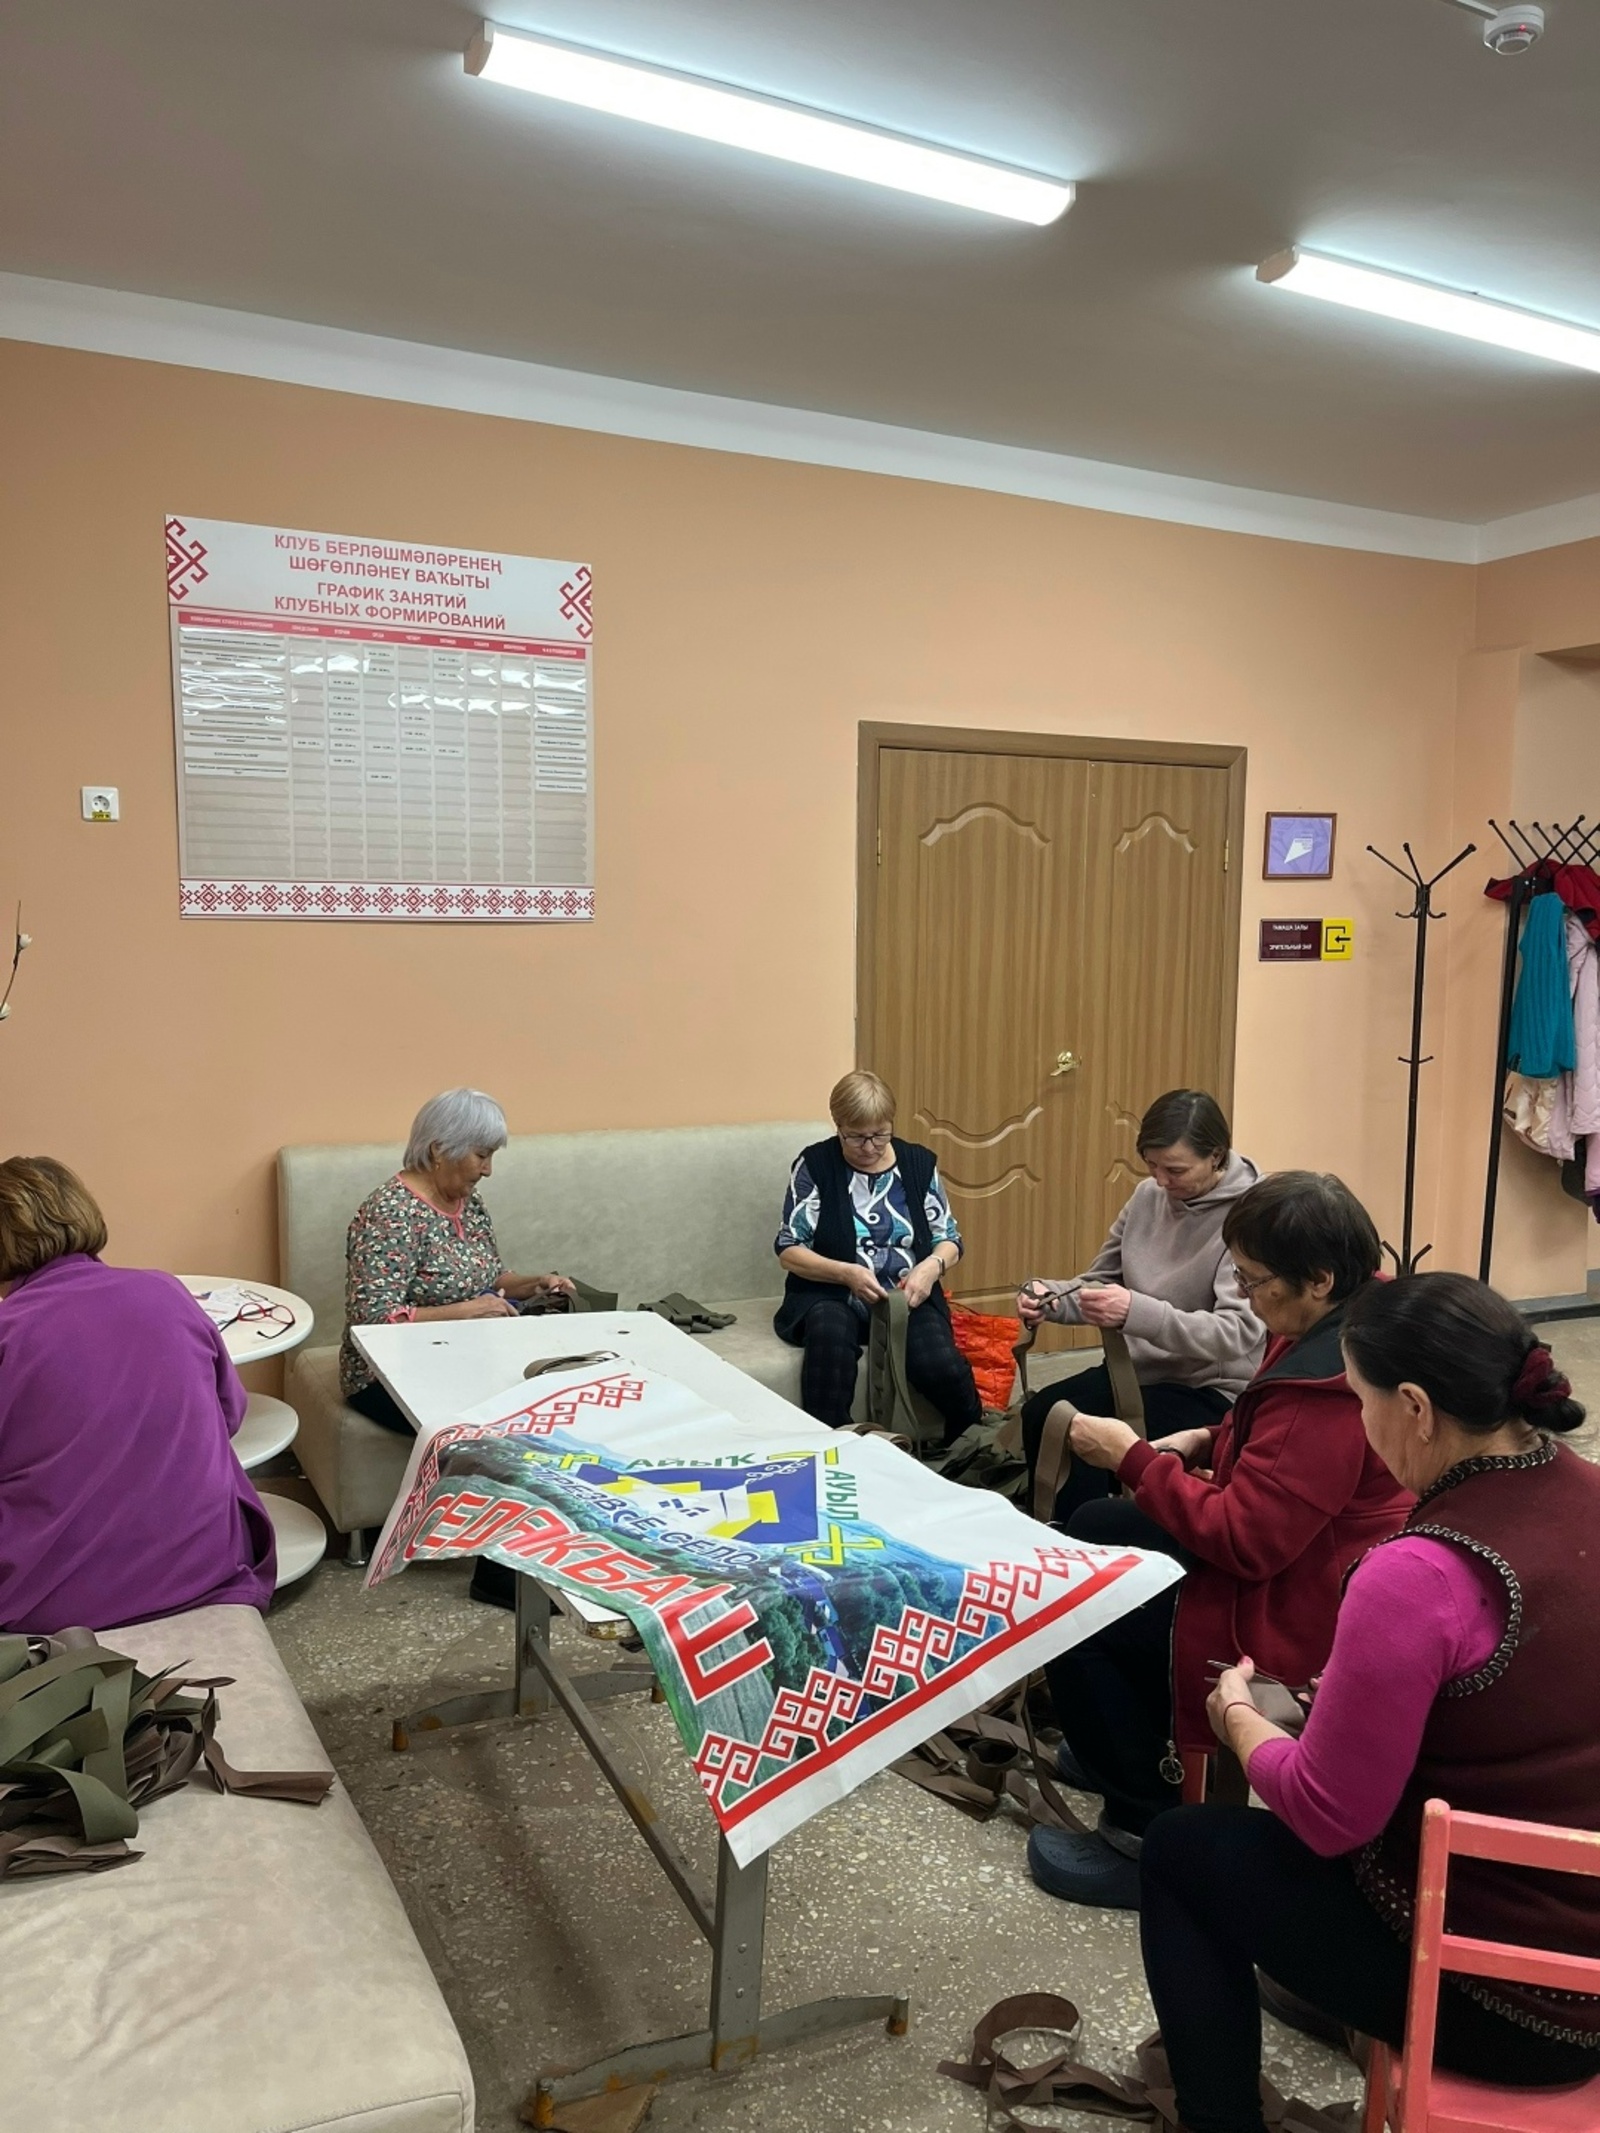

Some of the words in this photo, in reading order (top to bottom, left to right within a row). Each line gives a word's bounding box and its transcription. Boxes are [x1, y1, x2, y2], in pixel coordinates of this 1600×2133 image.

[274, 534, 321, 552] КЛУБ
[326, 540, 503, 575] БЕРЛӘШМӘЛӘРЕНЕҢ
[317, 582, 385, 602] ГРАФИК
[389, 588, 467, 610] ЗАНЯТИЙ
[415, 569, 490, 590] ВАҠЫТЫ
[274, 596, 361, 617] КЛУБНЫХ
[365, 604, 506, 630] ФОРМИРОВАНИЙ
[823, 1469, 860, 1521] АУЫЛ
